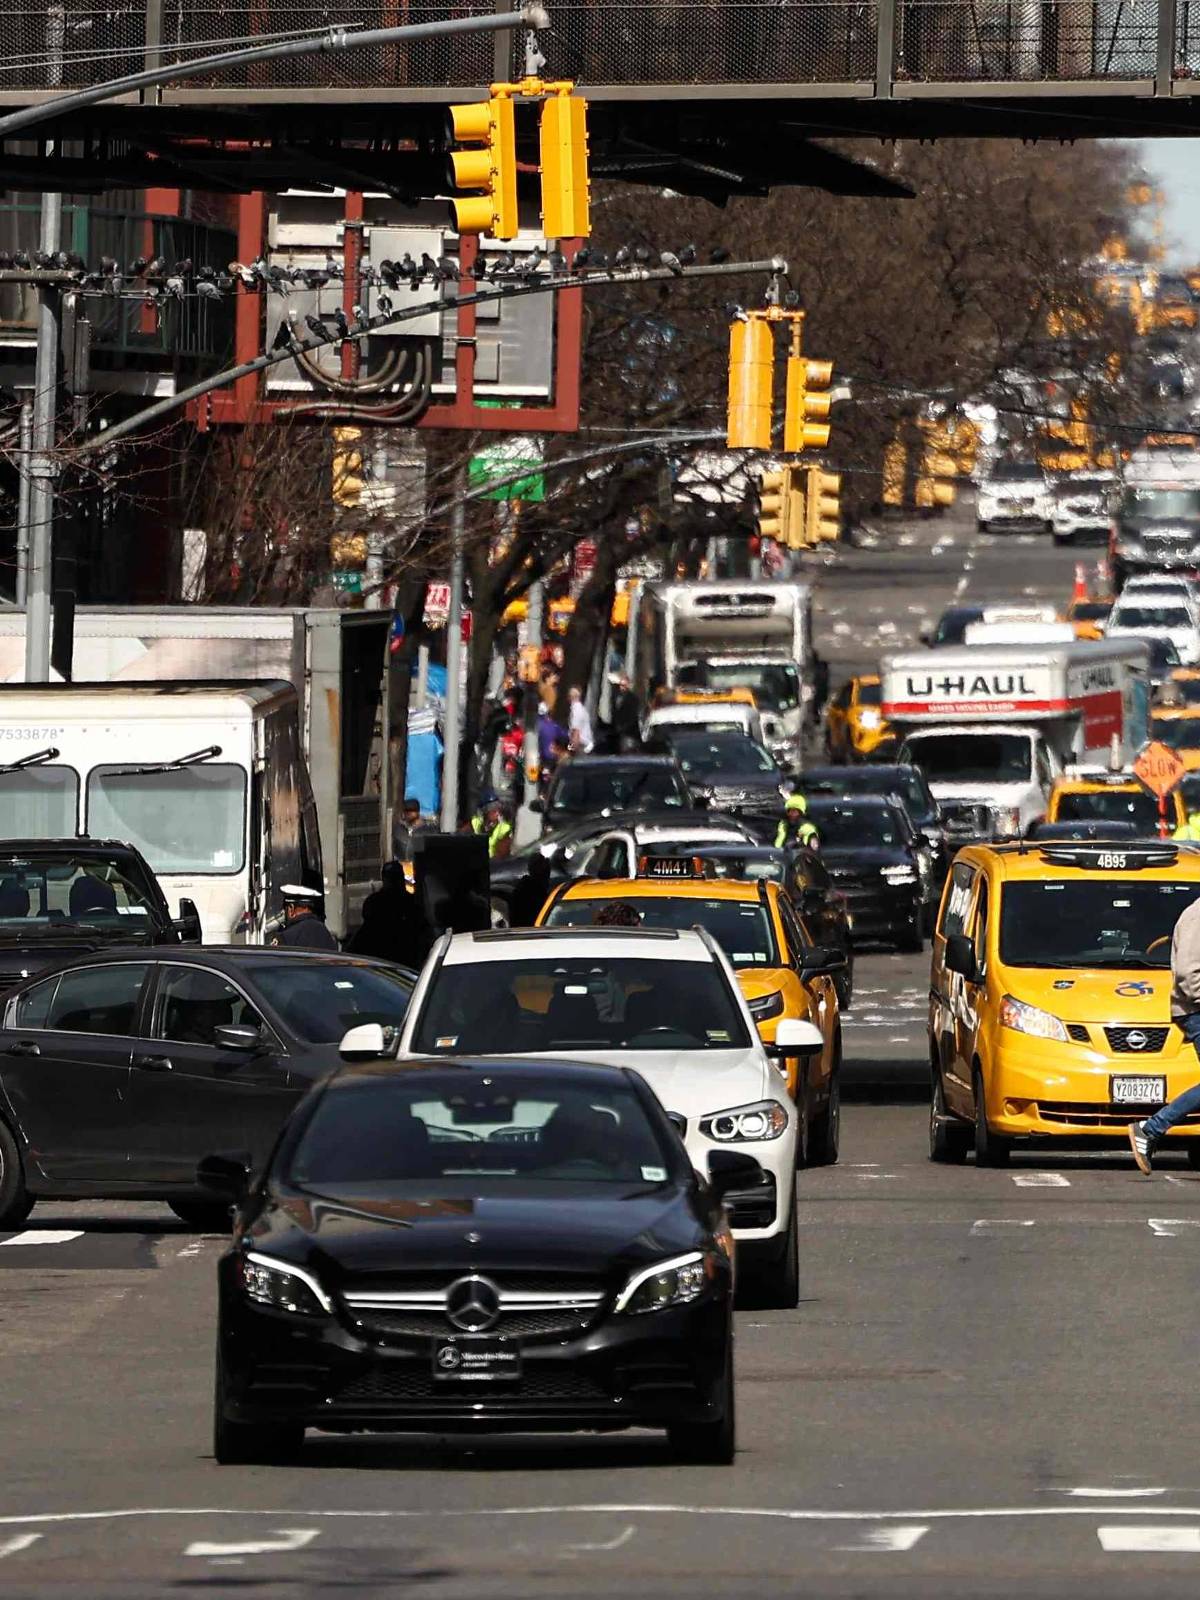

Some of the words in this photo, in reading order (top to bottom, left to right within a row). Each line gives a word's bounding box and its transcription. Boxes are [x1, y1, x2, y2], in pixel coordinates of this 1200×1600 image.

[1140, 758, 1177, 779] SLOW
[653, 860, 687, 875] 4M41
[1097, 854, 1127, 869] 4B95
[1116, 1083, 1160, 1097] Y208327C
